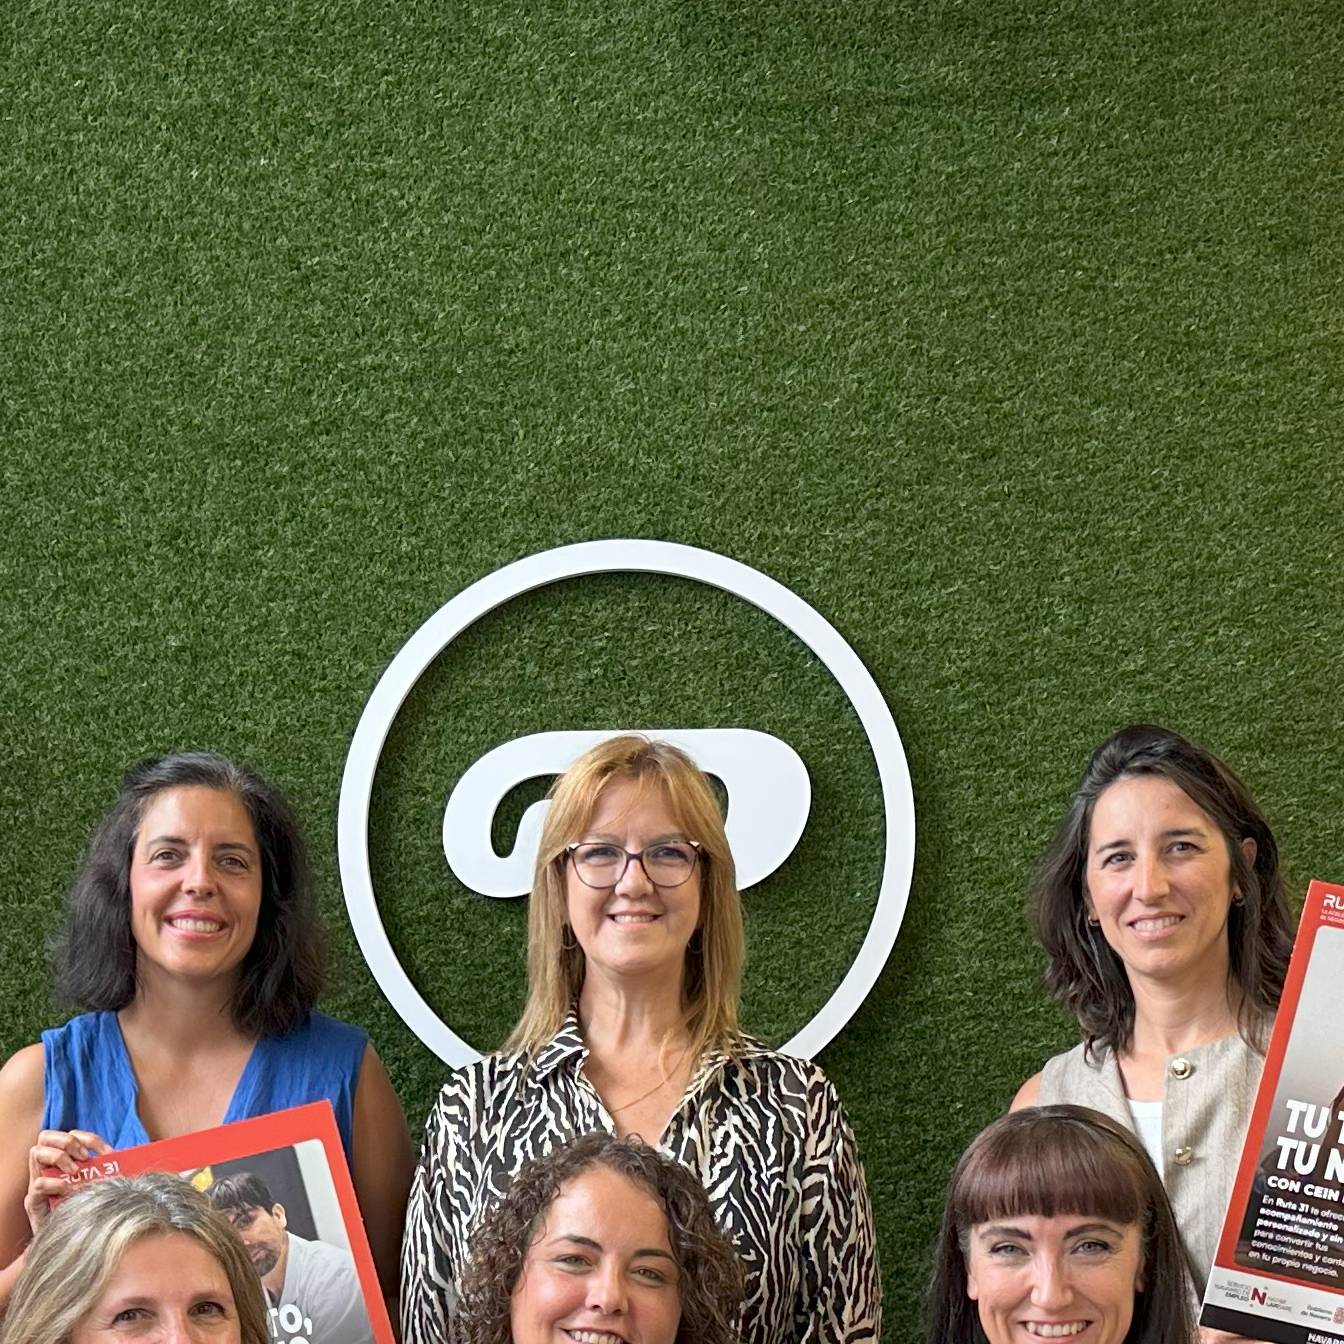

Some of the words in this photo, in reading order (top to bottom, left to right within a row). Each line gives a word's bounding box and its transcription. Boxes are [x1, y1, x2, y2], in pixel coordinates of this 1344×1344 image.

[1286, 1099, 1330, 1138] TU
[102, 1161, 119, 1175] 31
[1276, 1136, 1321, 1175] TU
[1267, 1175, 1302, 1193] CON
[1303, 1183, 1339, 1202] CEIN
